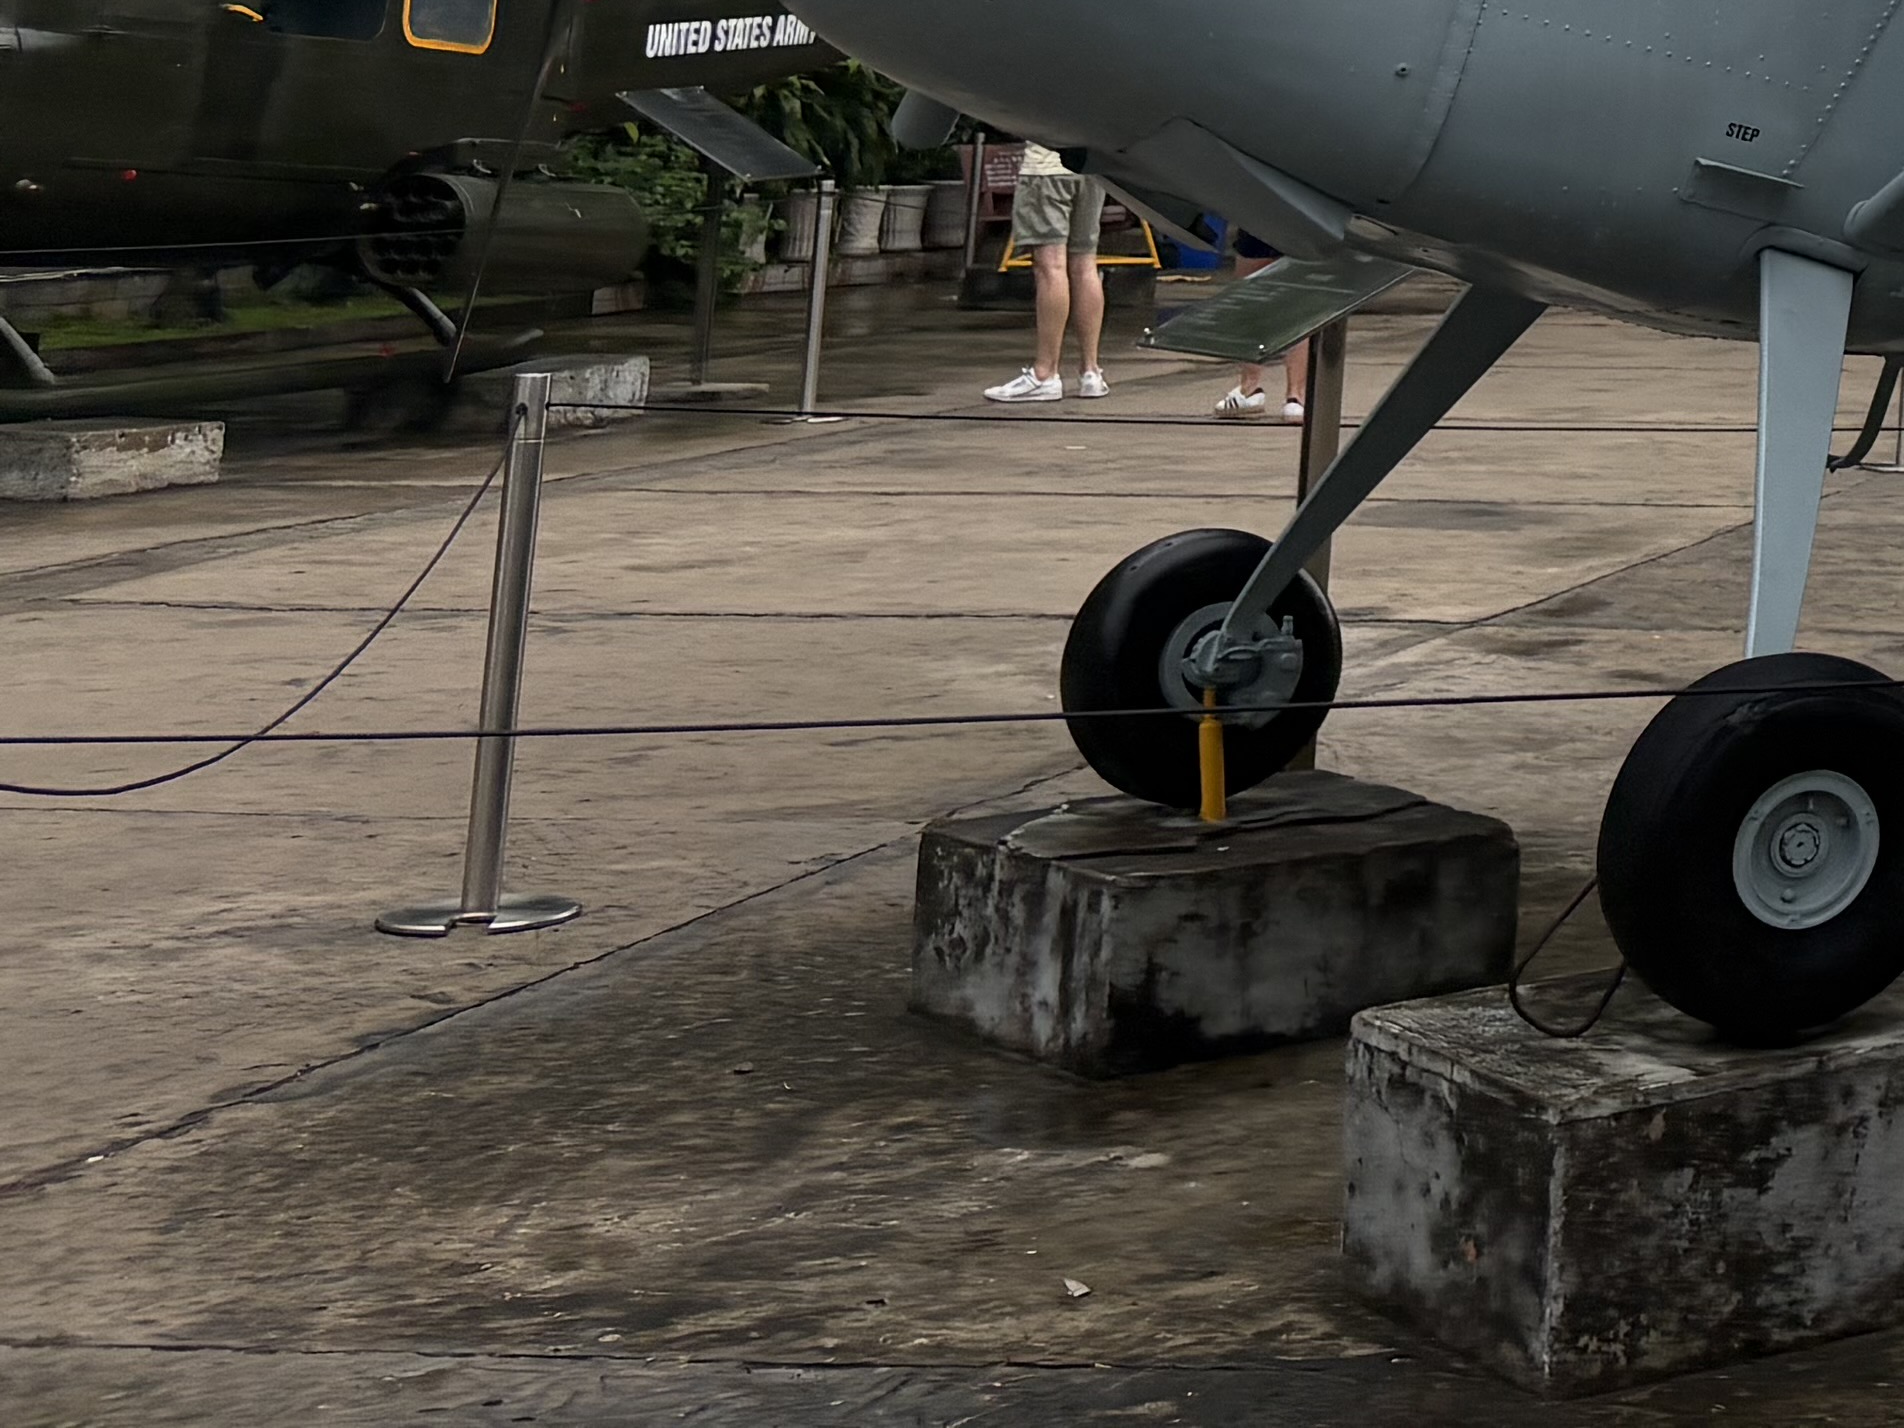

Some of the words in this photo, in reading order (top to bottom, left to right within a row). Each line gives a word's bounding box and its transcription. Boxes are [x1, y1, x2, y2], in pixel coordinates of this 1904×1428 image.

[645, 20, 712, 58] UNITED
[713, 15, 772, 52] STATES
[1725, 122, 1760, 143] STEP
